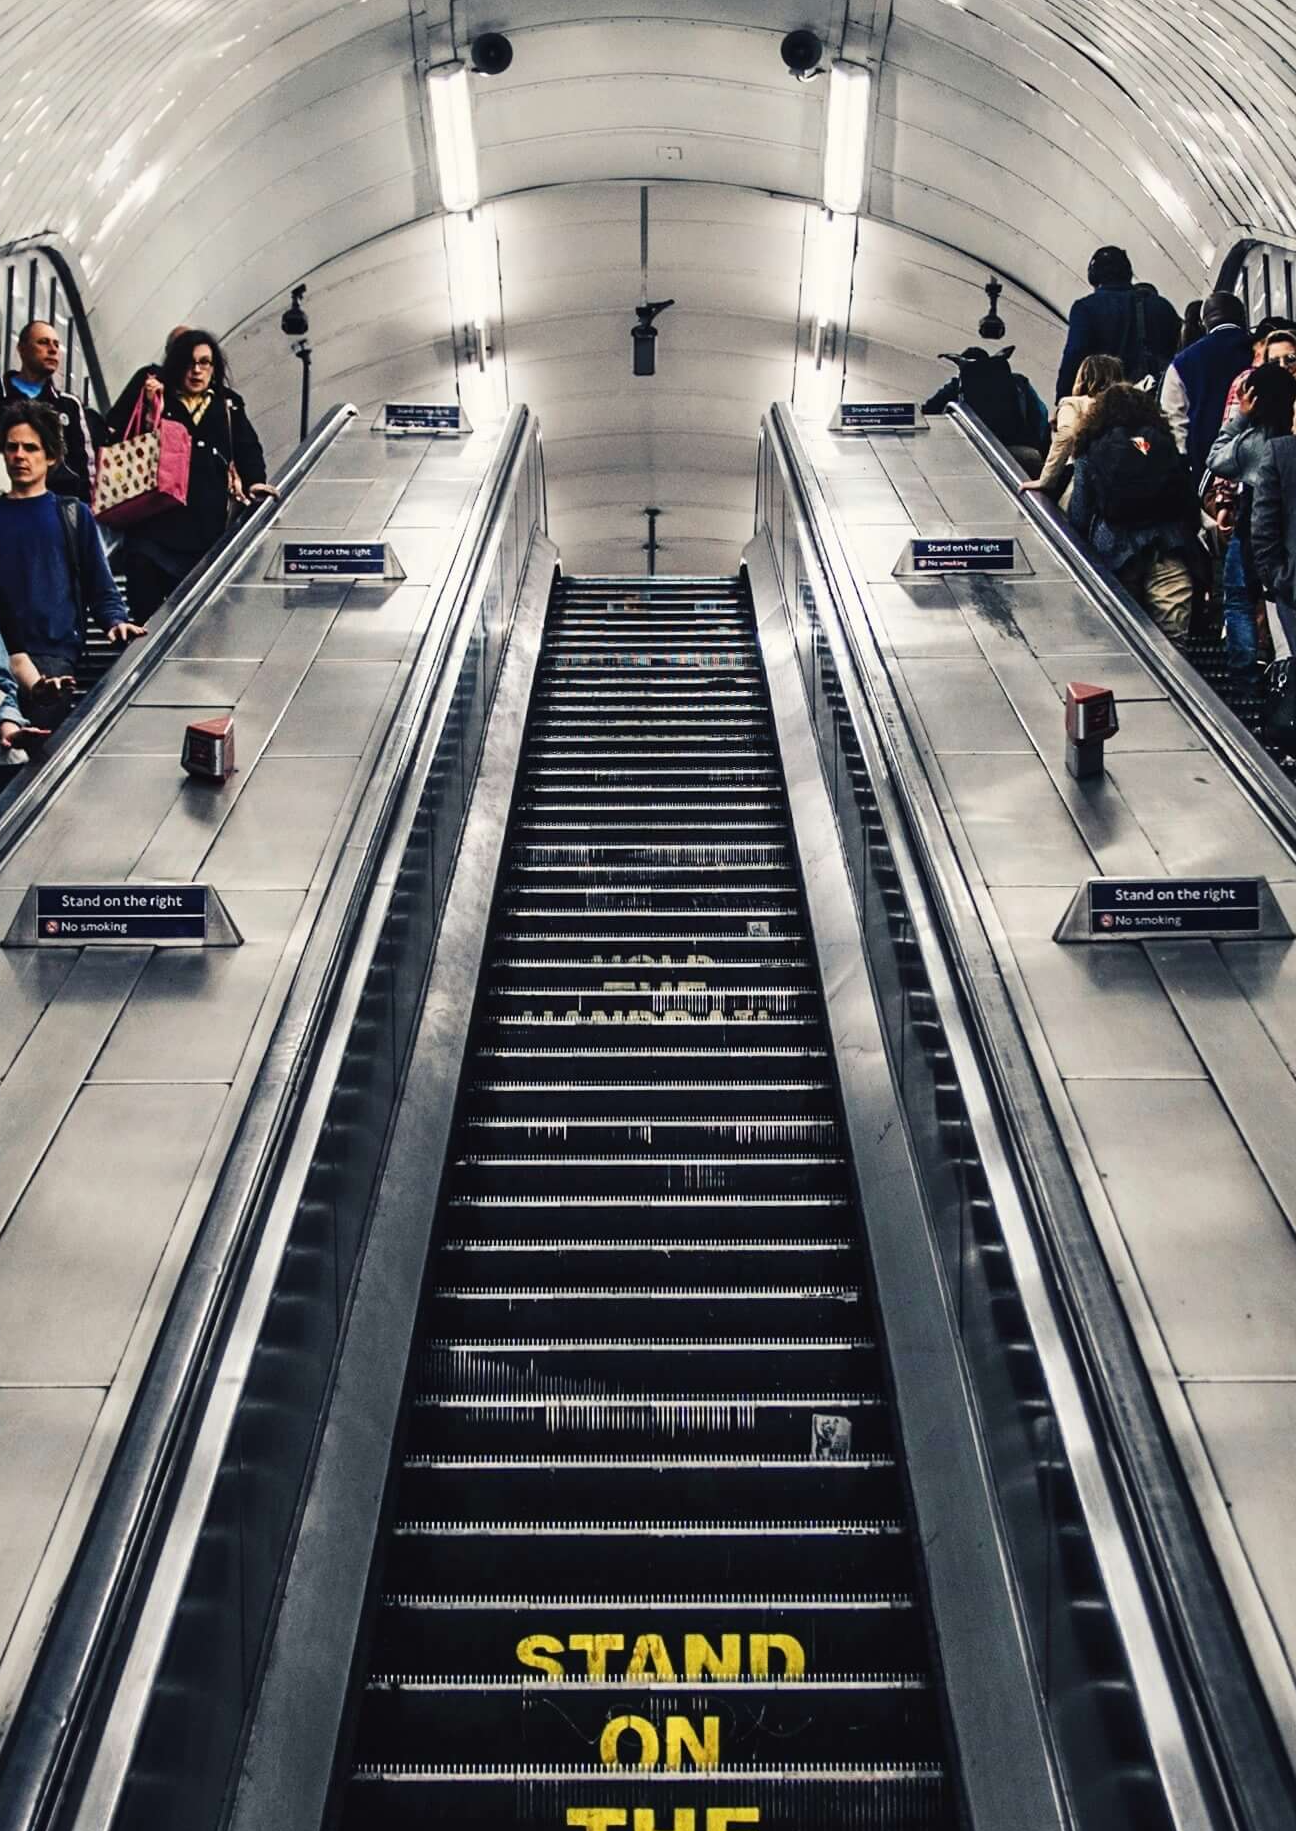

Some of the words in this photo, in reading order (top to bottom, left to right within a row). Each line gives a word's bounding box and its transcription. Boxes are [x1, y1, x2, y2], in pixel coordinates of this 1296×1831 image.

[298, 547, 323, 556] Stand
[335, 548, 350, 556] the
[351, 548, 372, 558] right
[927, 543, 952, 552] Stand
[964, 544, 979, 552] the
[980, 543, 1000, 554] right
[61, 895, 101, 907] Stand
[104, 897, 120, 907] on
[124, 895, 148, 907] the
[150, 895, 183, 909] right
[1115, 888, 1154, 902] Stand
[1157, 891, 1174, 901] on
[1177, 888, 1201, 900] the
[1203, 887, 1236, 904] right
[61, 921, 78, 932] No
[81, 921, 128, 934] smoking
[1115, 916, 1133, 926] No
[1134, 915, 1182, 927] smoking
[516, 1634, 806, 1681] STAND
[600, 1715, 720, 1770] ON
